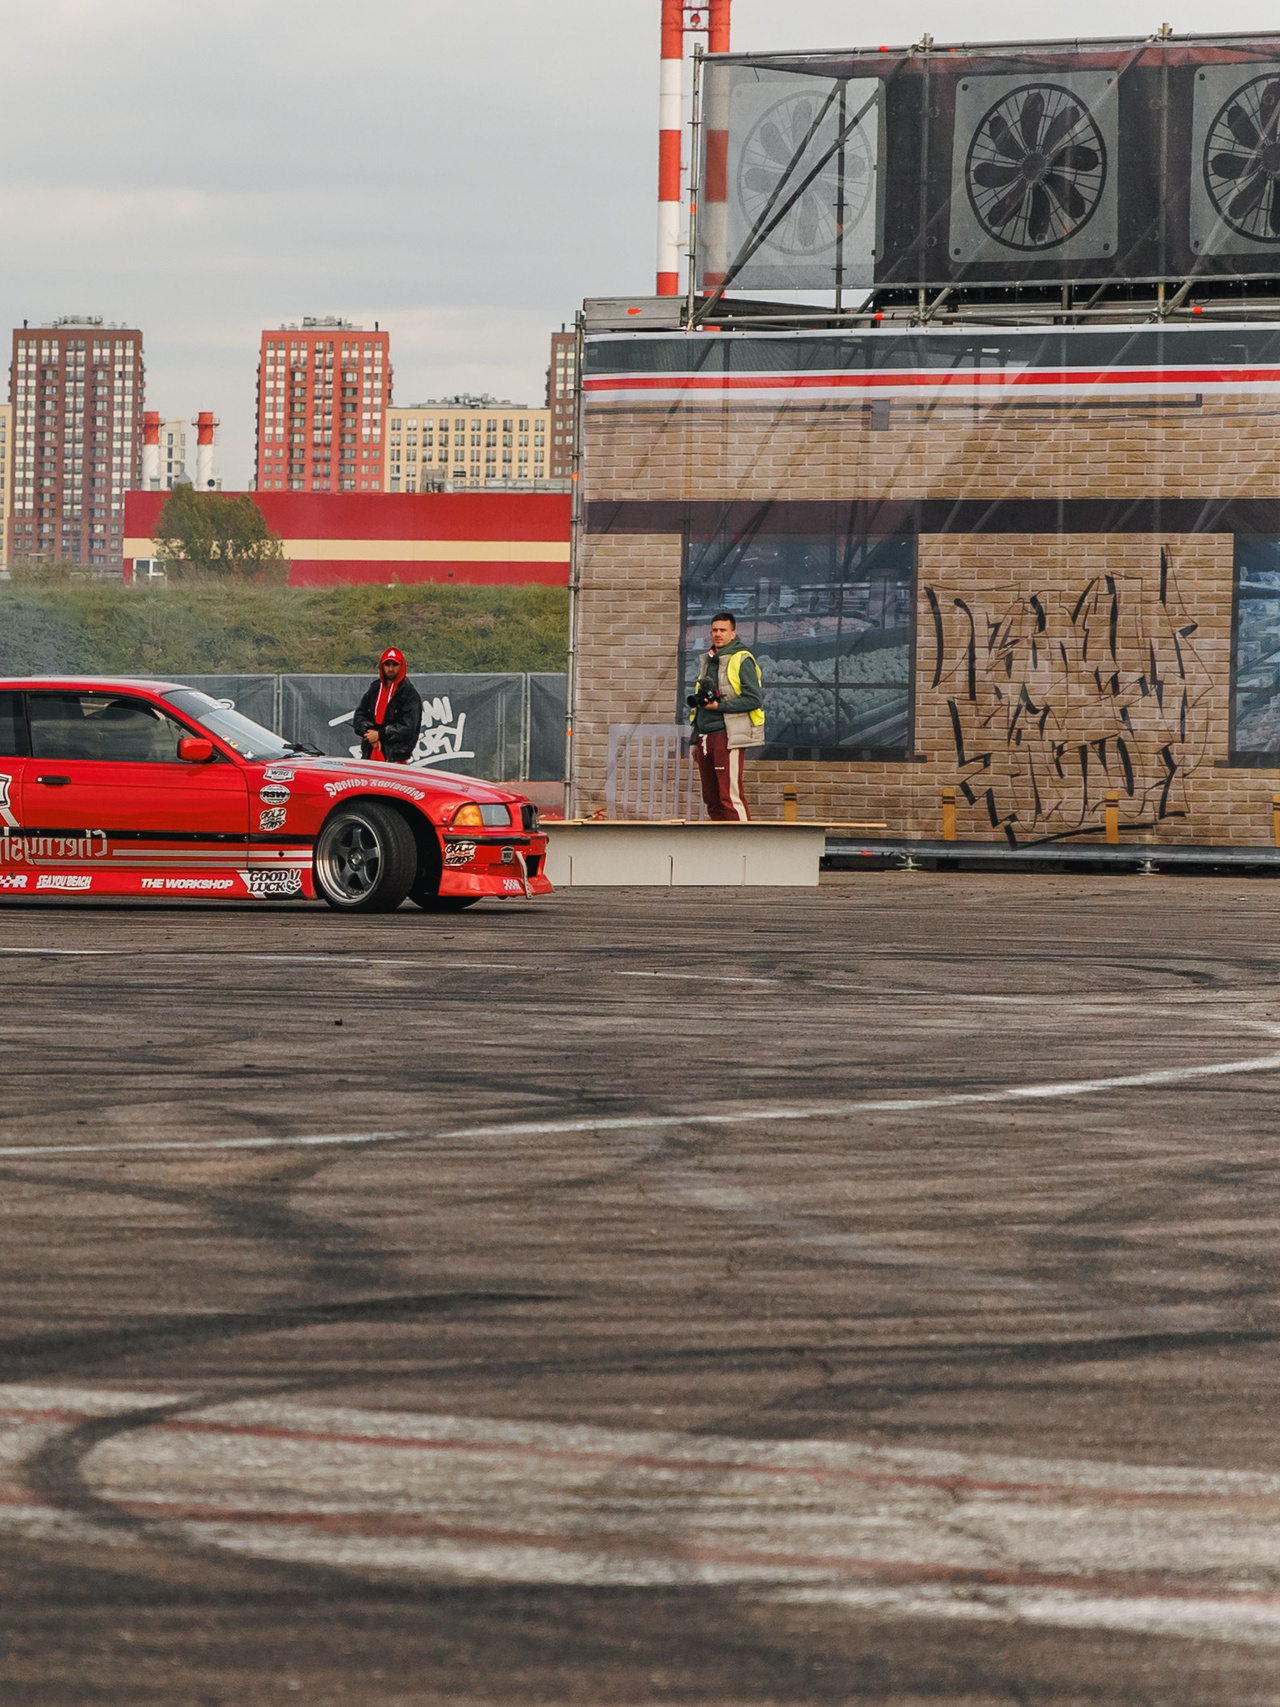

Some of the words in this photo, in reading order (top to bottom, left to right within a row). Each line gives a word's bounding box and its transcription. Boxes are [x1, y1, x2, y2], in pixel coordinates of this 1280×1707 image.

[270, 769, 290, 777] WSG
[261, 808, 286, 820] GOLD
[37, 875, 52, 887] SEA
[51, 875, 68, 887] YOU
[67, 875, 92, 888] BEACH
[249, 871, 288, 882] GOOD
[141, 878, 164, 888] THE
[165, 879, 234, 889] WORKSHOP
[248, 882, 286, 892] LUCK
